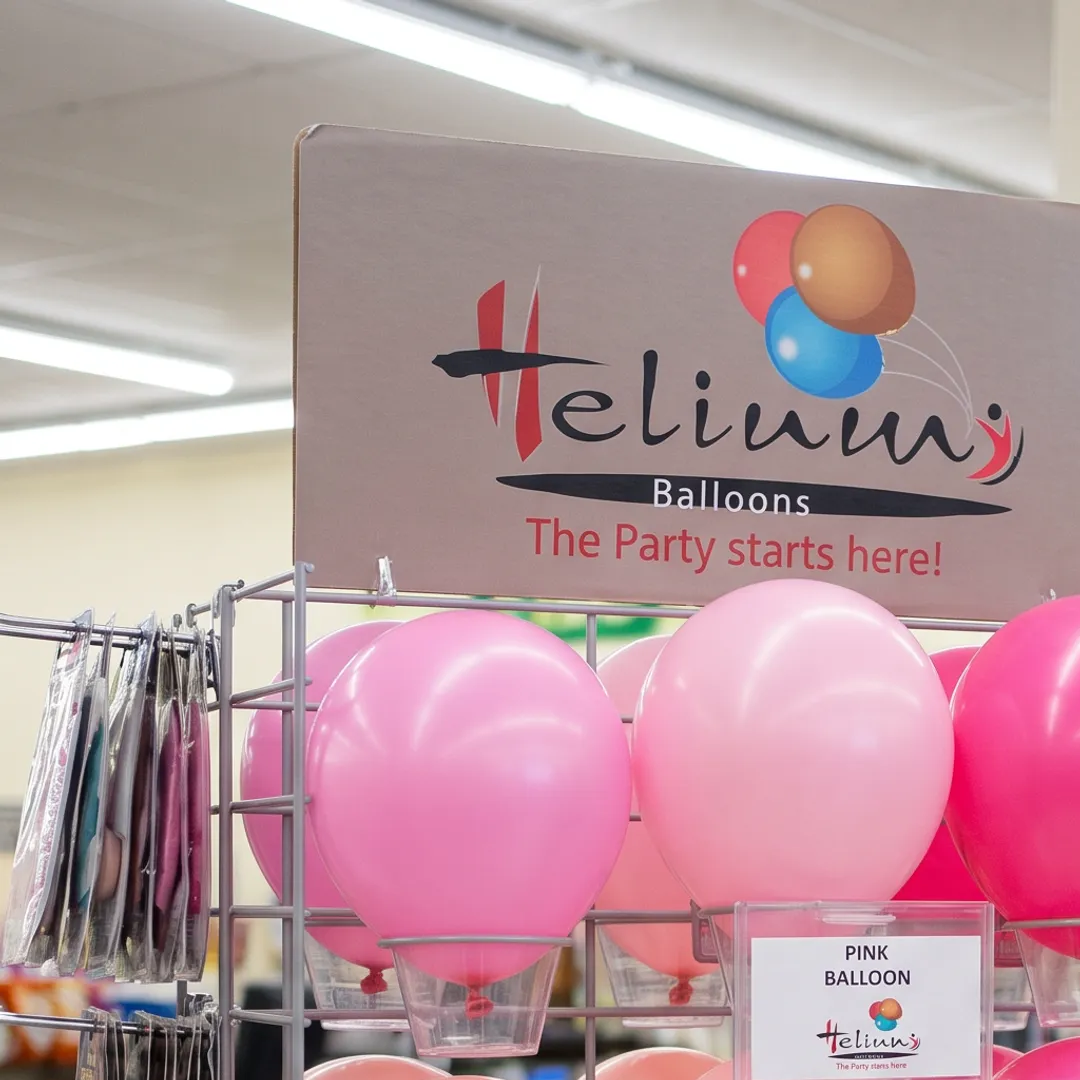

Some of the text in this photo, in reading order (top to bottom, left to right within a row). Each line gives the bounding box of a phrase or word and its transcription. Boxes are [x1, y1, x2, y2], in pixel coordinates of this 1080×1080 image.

[652, 478, 811, 517] Balloons
[526, 517, 942, 576] The Party starts here!
[845, 945, 889, 961] PINK
[825, 970, 911, 986] BALLOON
